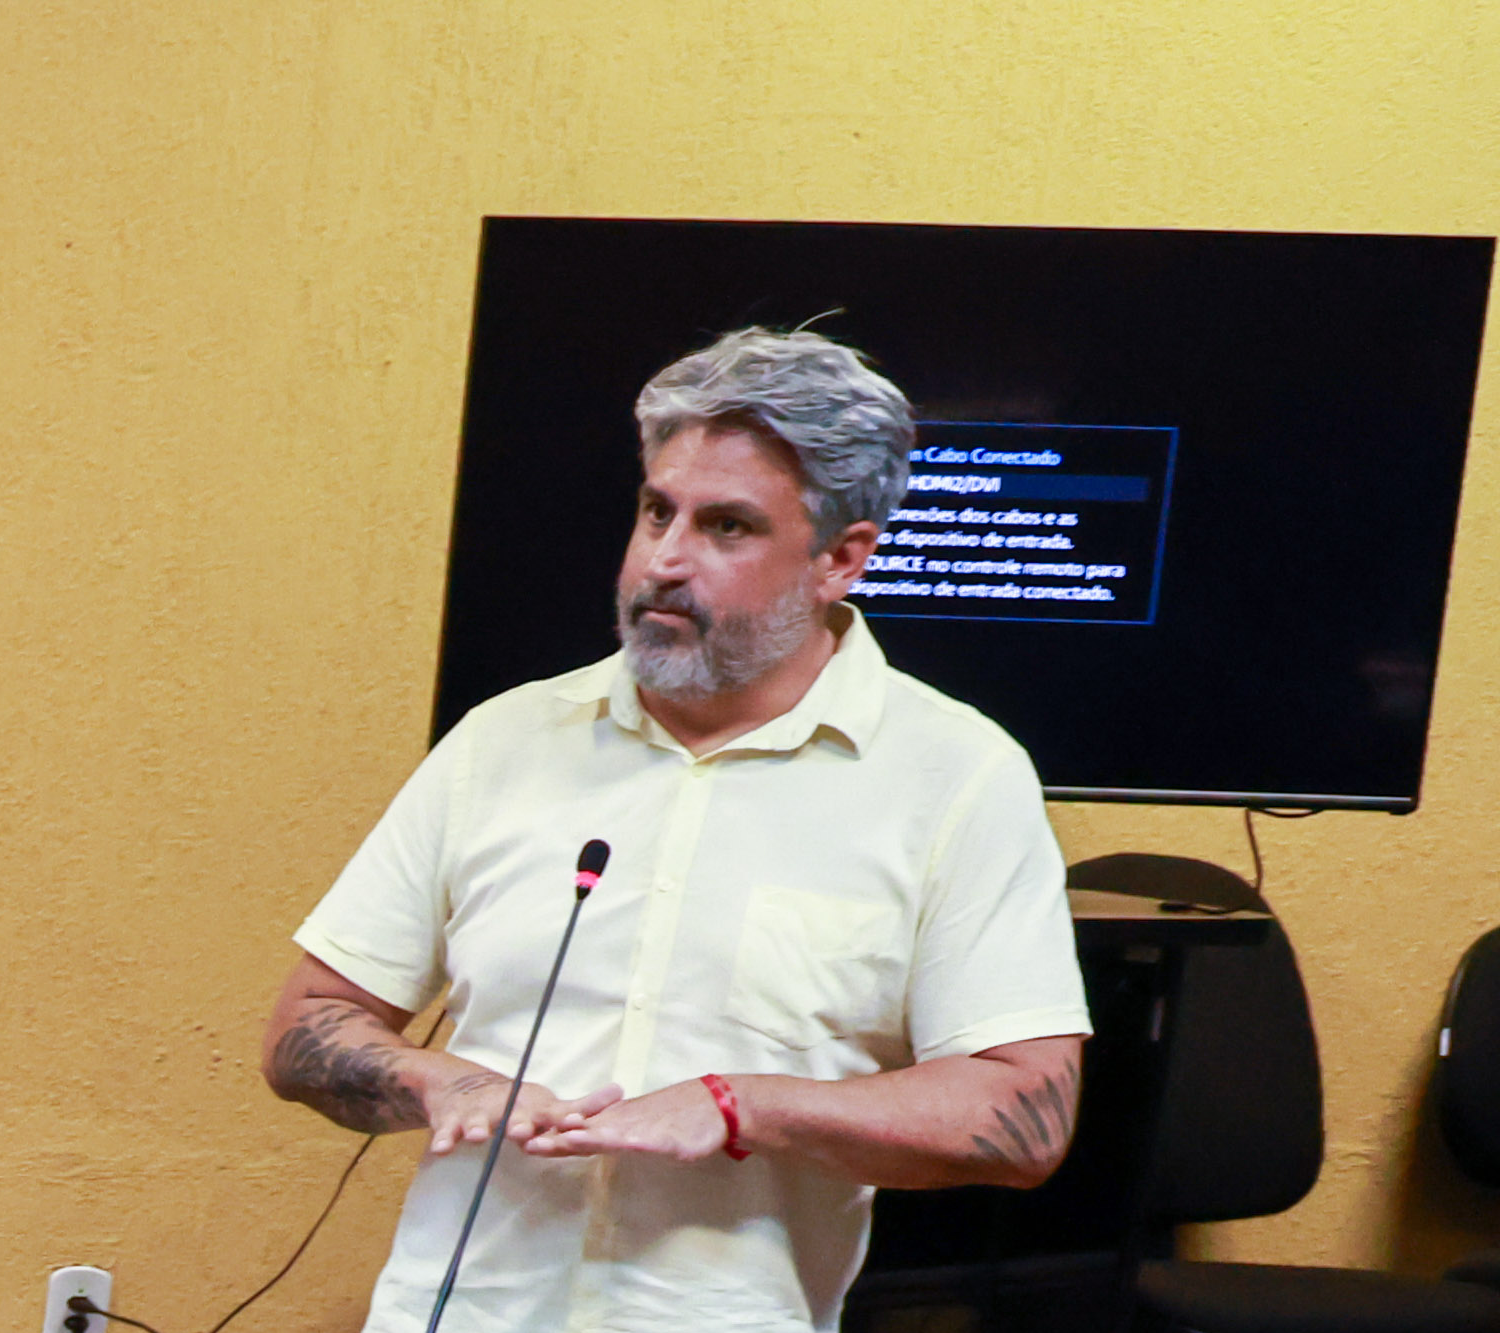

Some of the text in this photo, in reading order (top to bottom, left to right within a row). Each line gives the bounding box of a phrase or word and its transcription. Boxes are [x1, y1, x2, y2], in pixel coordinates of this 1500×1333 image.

[887, 506, 1079, 526] onexões dos cabos e as
[981, 531, 1006, 548] de
[925, 560, 951, 573] no
[951, 559, 1022, 575] controle
[1022, 562, 1085, 577] remoto
[1085, 564, 1127, 580] para
[932, 580, 958, 597] de
